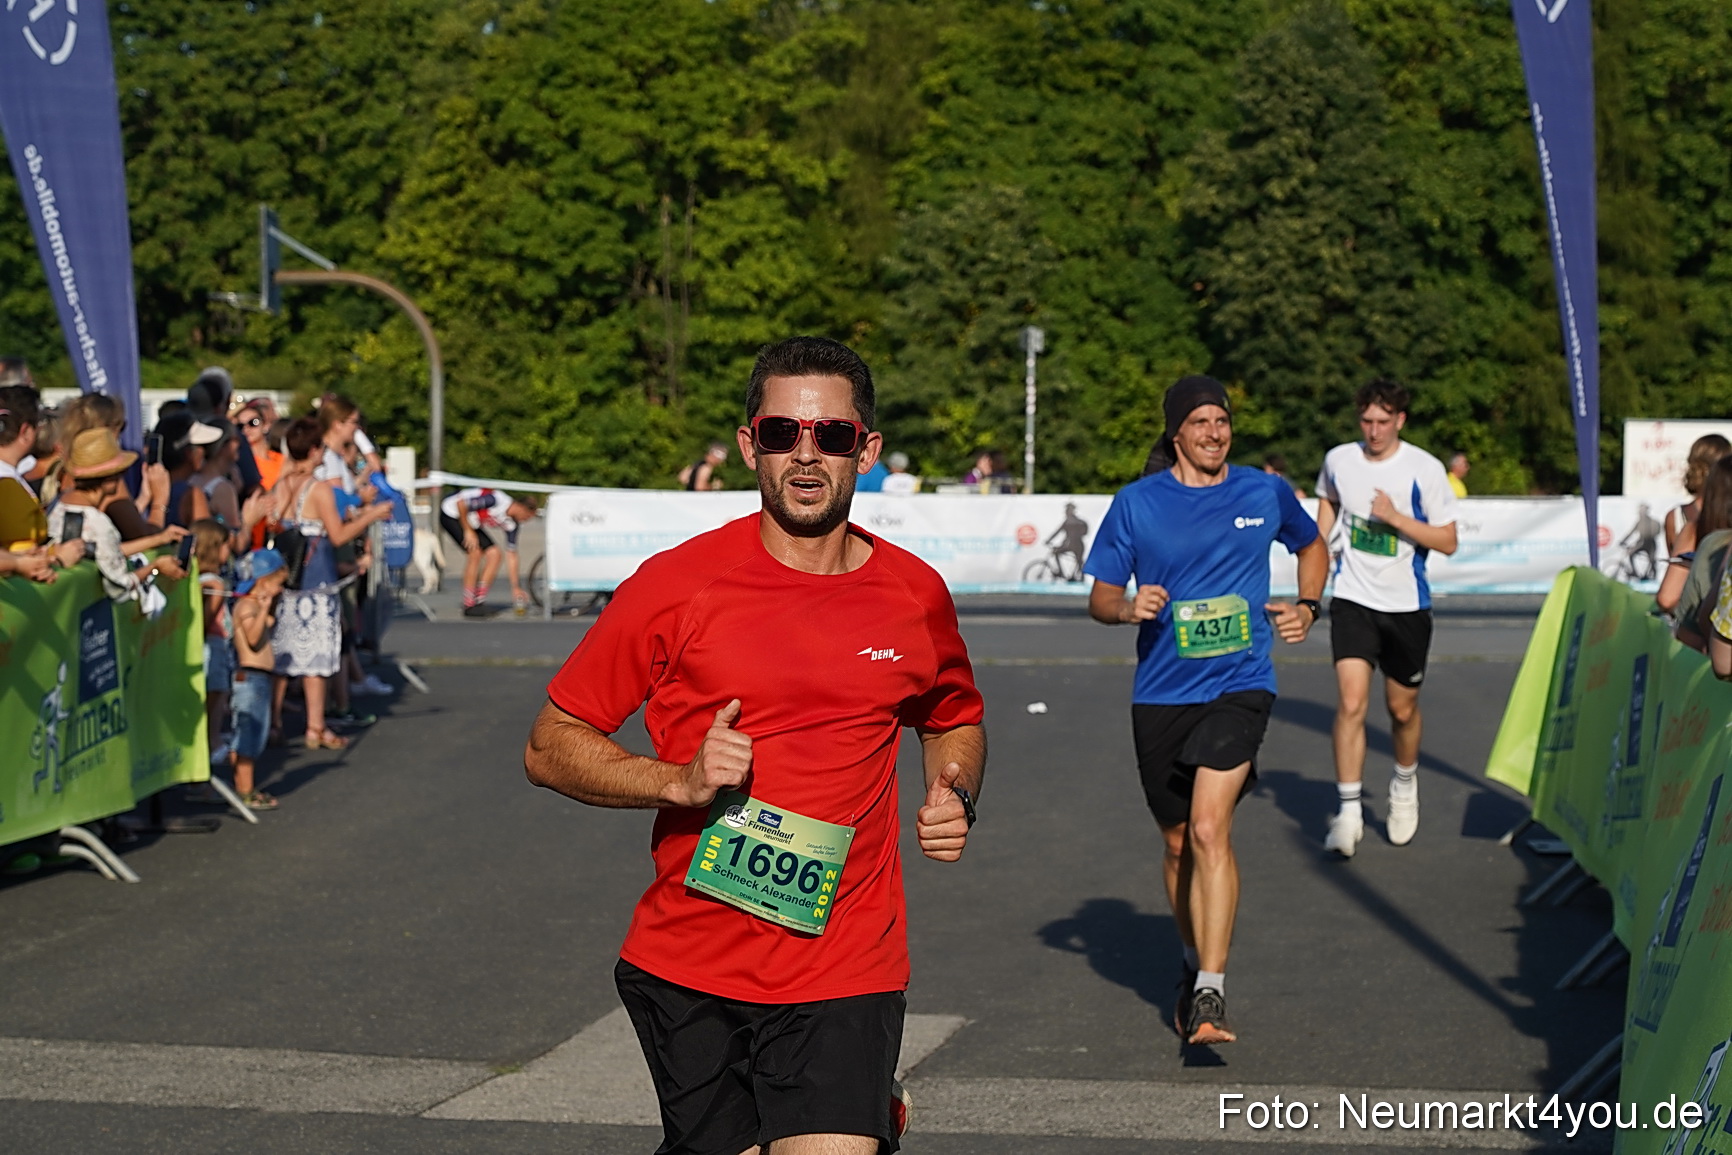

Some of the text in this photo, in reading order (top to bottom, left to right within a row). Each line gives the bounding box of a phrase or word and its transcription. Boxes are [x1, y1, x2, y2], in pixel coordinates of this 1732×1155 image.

[1194, 615, 1233, 638] 437
[871, 648, 895, 661] DEHN
[747, 820, 796, 840] Firmenlauf
[763, 834, 792, 846] neumarkt
[699, 834, 724, 872] RUN
[727, 834, 824, 894] 1696
[712, 863, 758, 890] Schneck
[761, 884, 817, 909] Alexander
[813, 869, 838, 919] 2022
